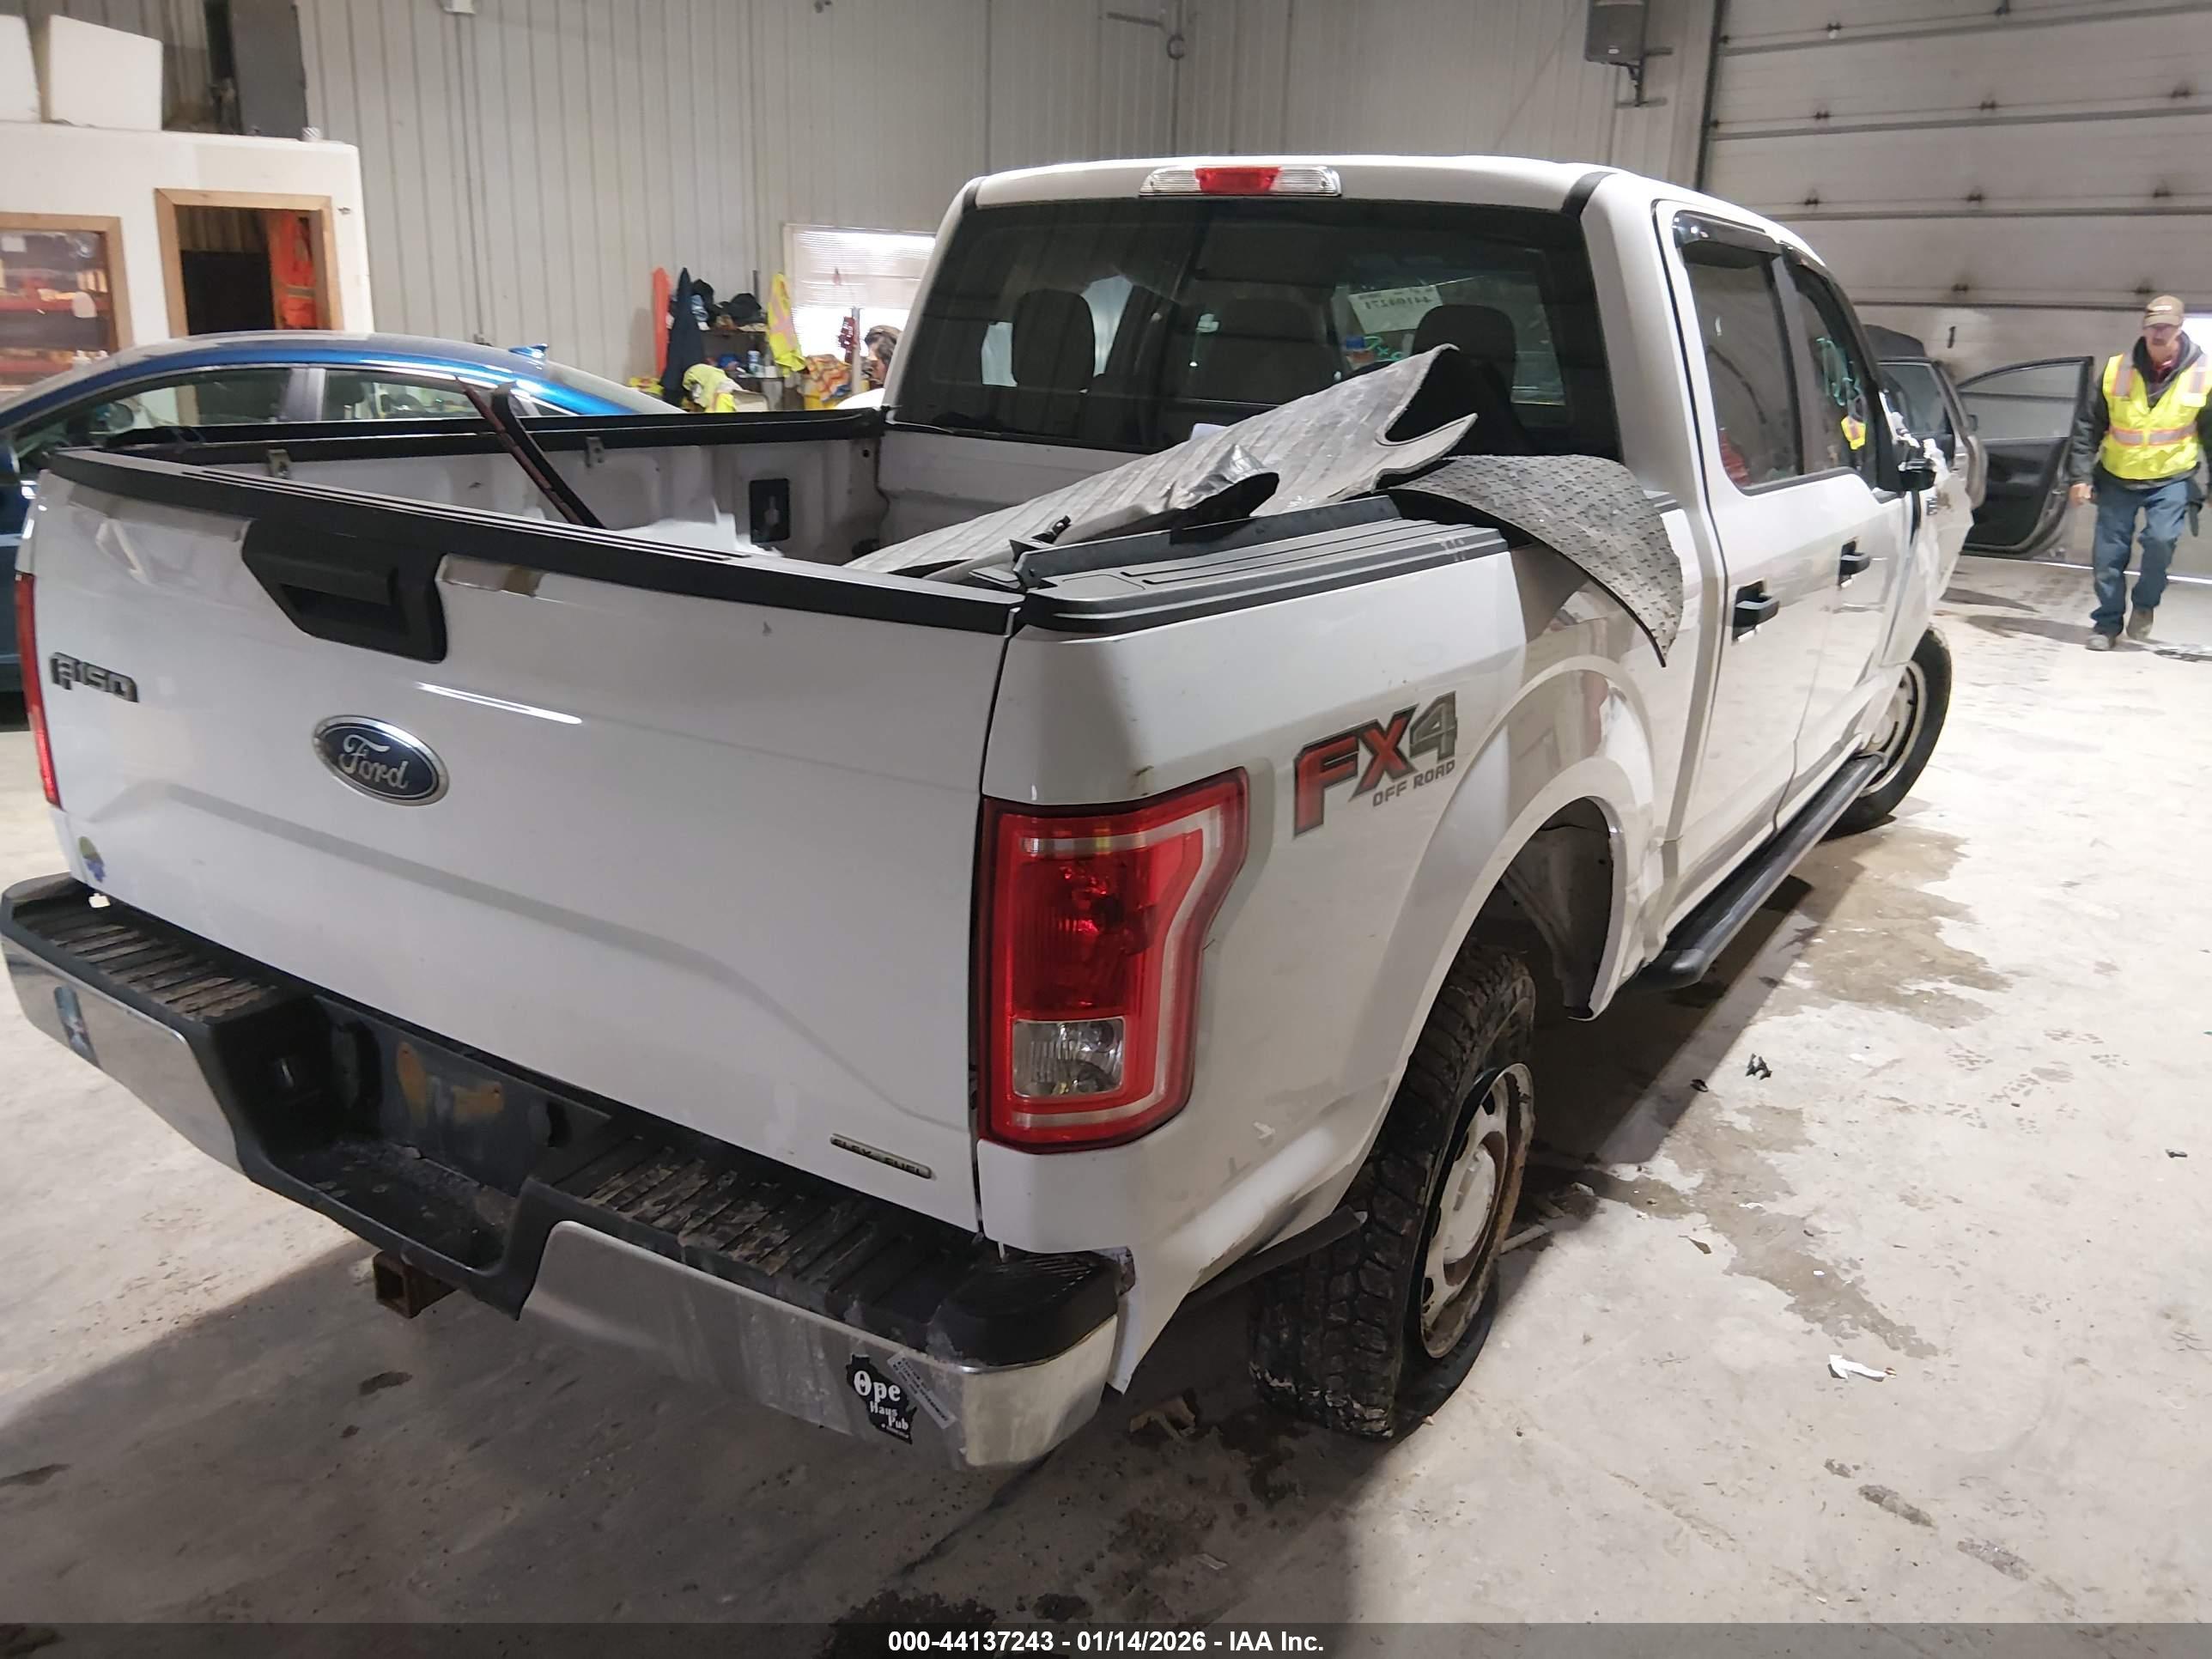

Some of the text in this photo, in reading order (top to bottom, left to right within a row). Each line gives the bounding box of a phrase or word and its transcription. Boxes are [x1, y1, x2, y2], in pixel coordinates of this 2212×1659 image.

[338, 734, 409, 790] Ford
[1292, 690, 1458, 840] FX4
[1372, 759, 1456, 807] OFF ROAD
[853, 1370, 902, 1403] Ope
[869, 1401, 899, 1418] Haus
[887, 1415, 910, 1439] Pub
